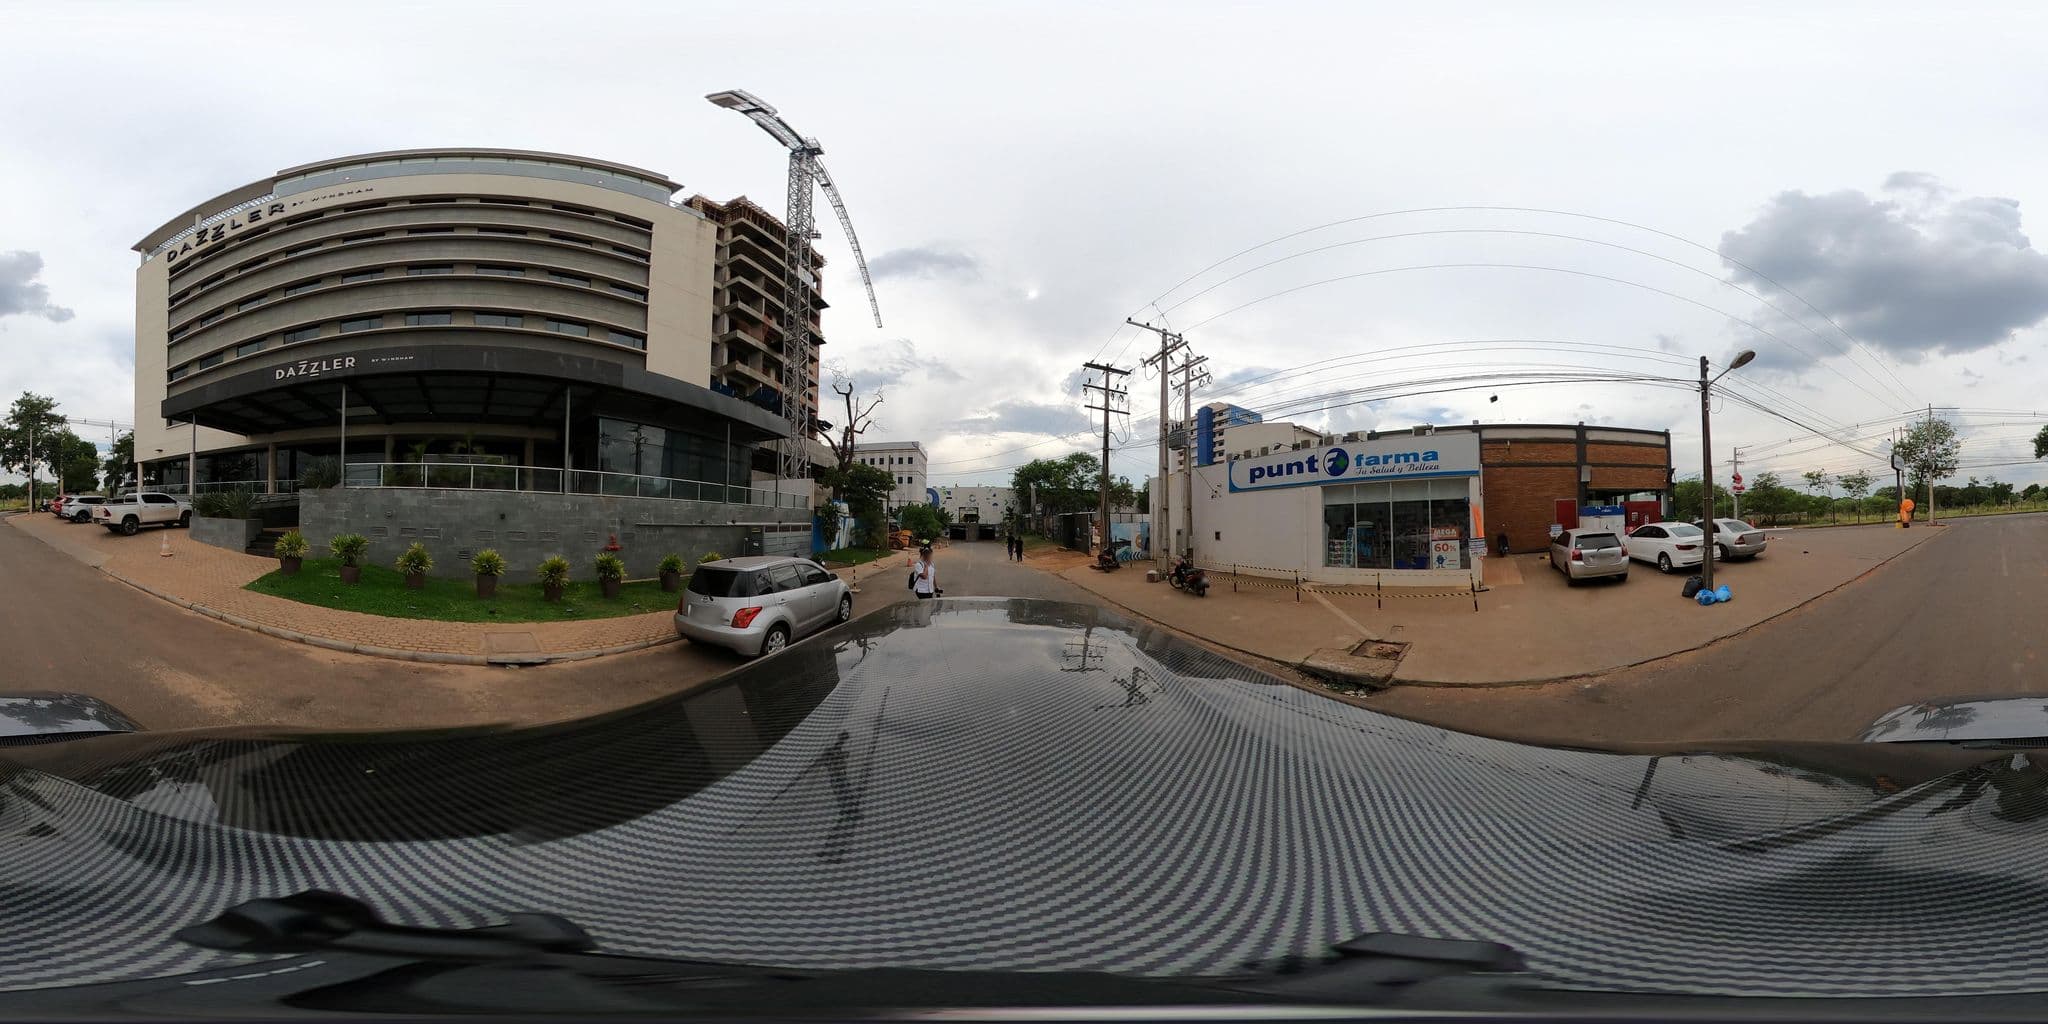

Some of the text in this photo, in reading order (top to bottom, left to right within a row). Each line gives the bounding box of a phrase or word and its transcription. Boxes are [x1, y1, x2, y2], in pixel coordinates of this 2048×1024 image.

[167, 203, 285, 262] DAZZLER
[275, 356, 356, 380] DAZZLER
[1354, 450, 1439, 467] farma
[1369, 465, 1396, 475] Salud
[1407, 463, 1440, 472] Belleza
[1434, 543, 1457, 552] 60%
